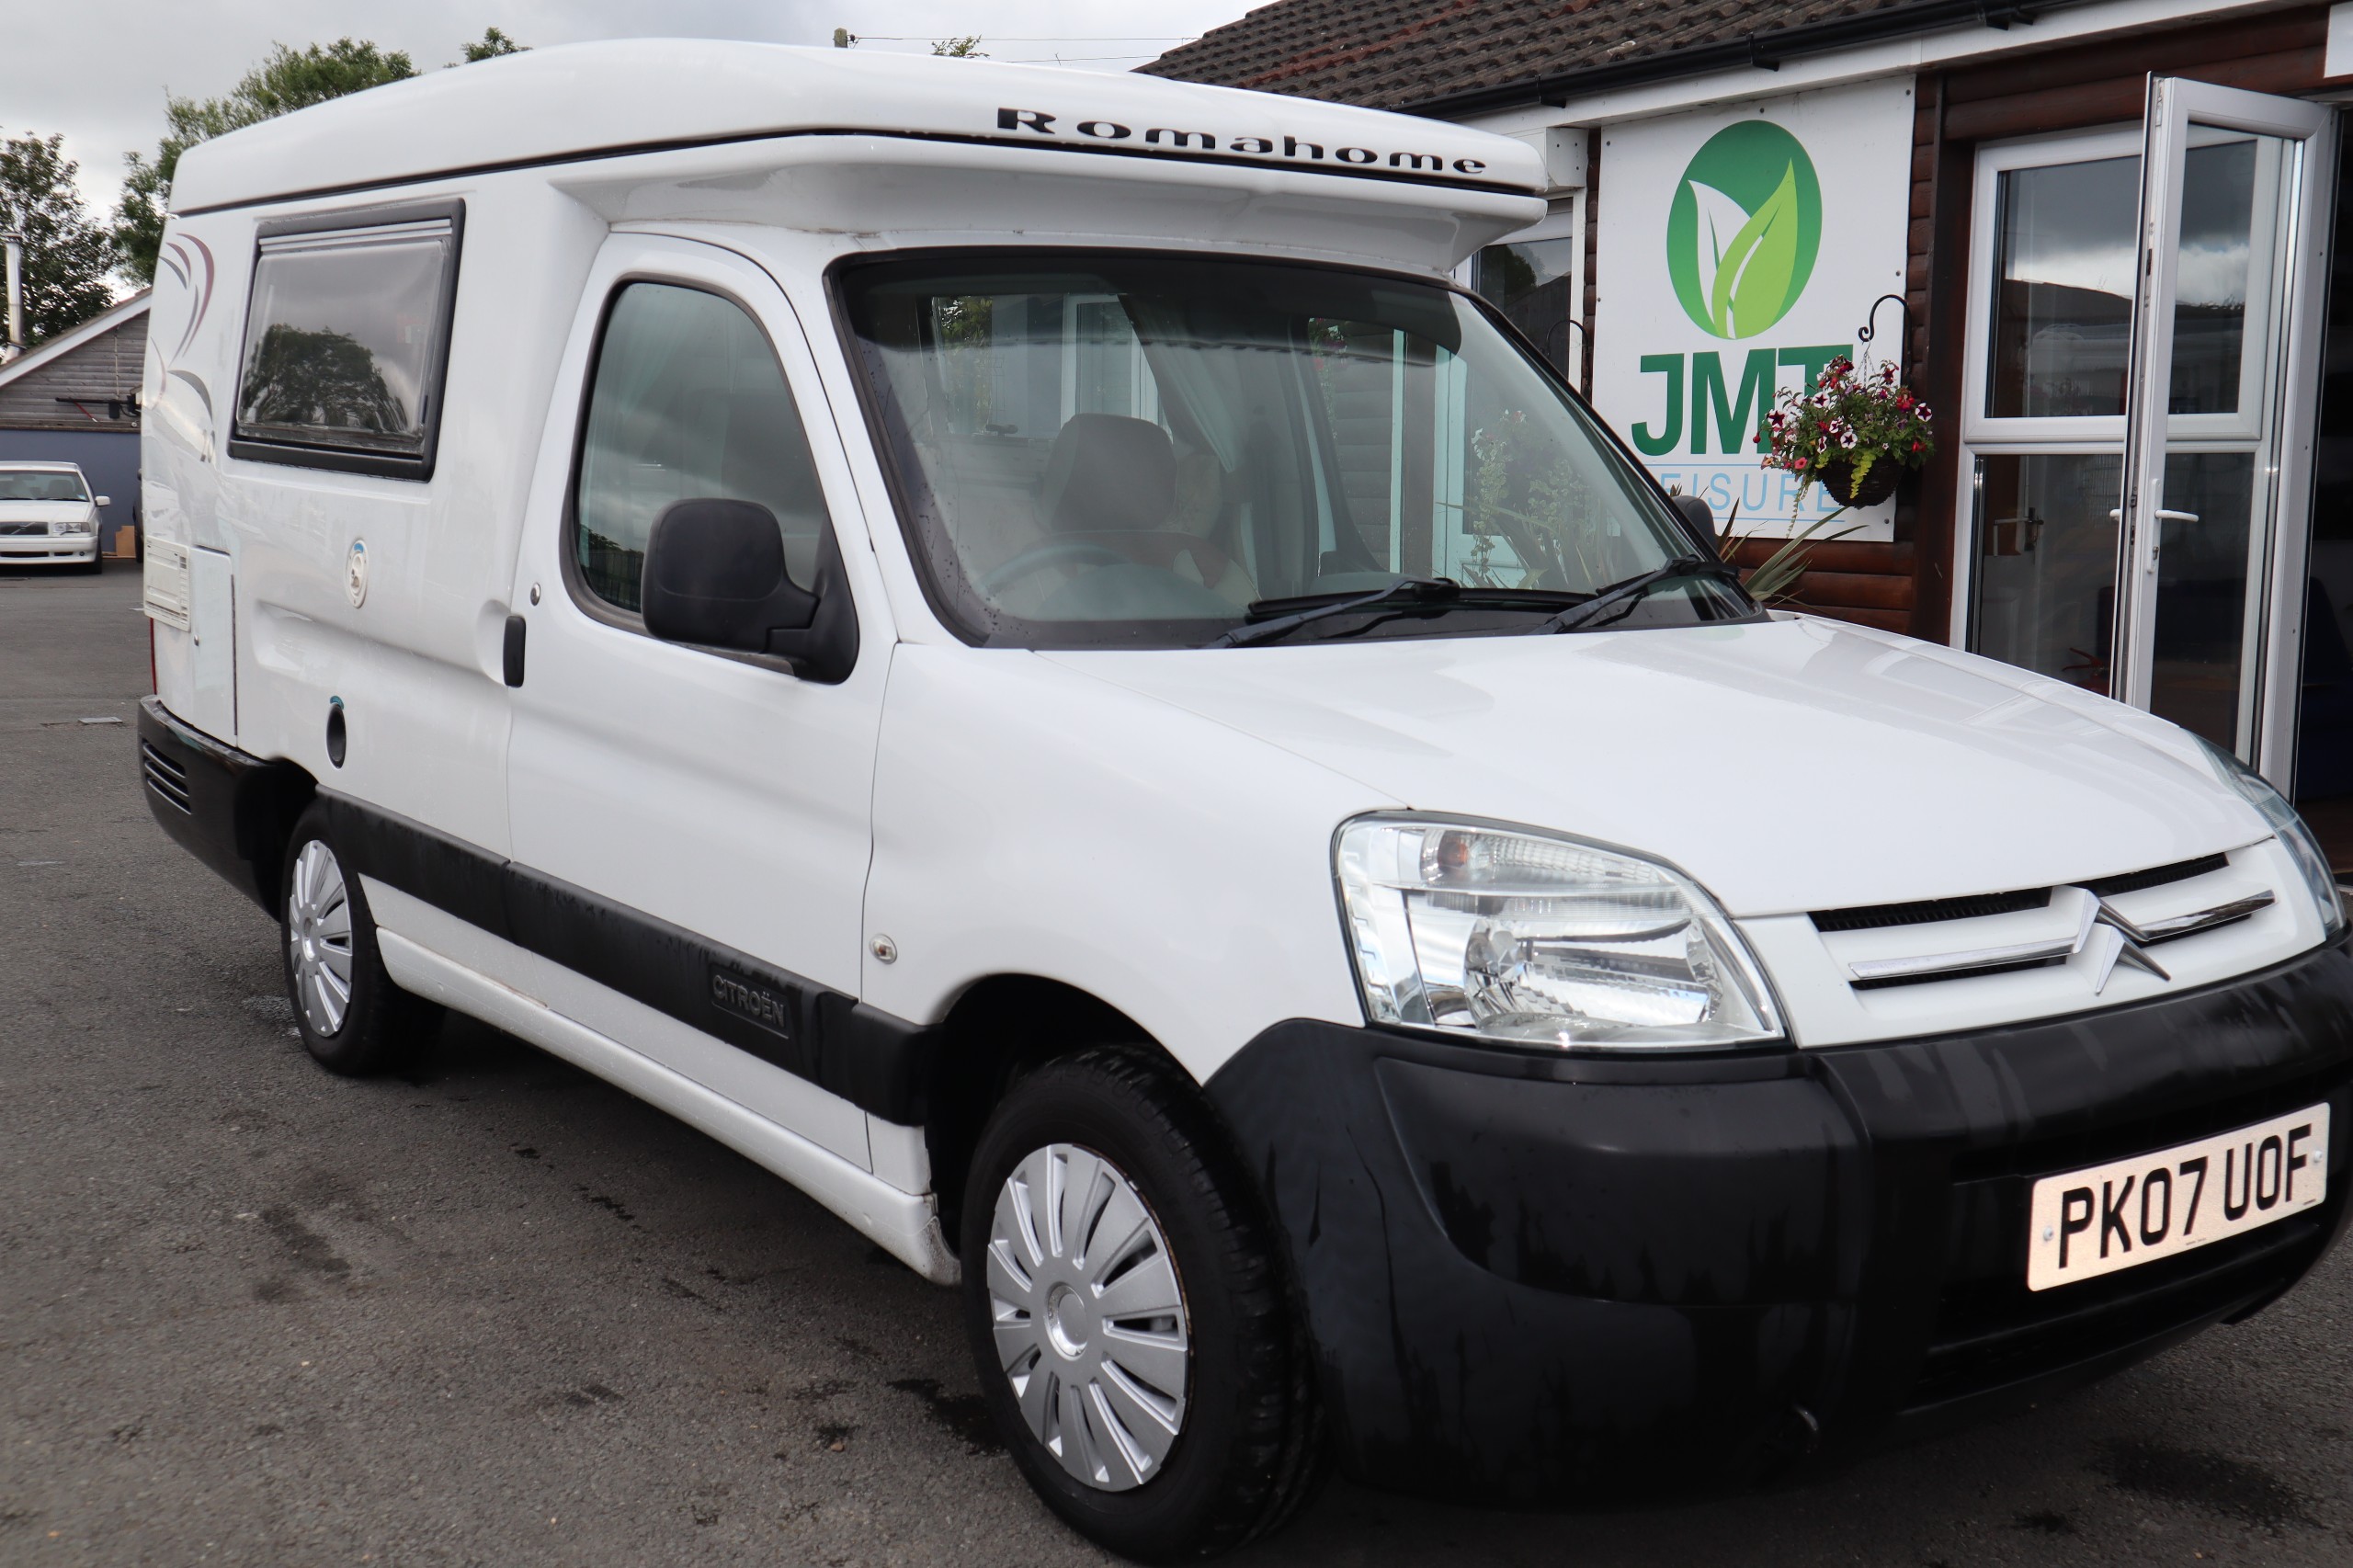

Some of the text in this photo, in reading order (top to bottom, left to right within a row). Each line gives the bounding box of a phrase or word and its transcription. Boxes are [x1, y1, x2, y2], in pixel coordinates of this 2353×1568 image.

[997, 107, 1486, 173] Romahome
[1660, 472, 1840, 511] ISURE
[713, 974, 784, 1028] CITROËN
[2059, 1123, 2312, 1268] PK07 UOF
